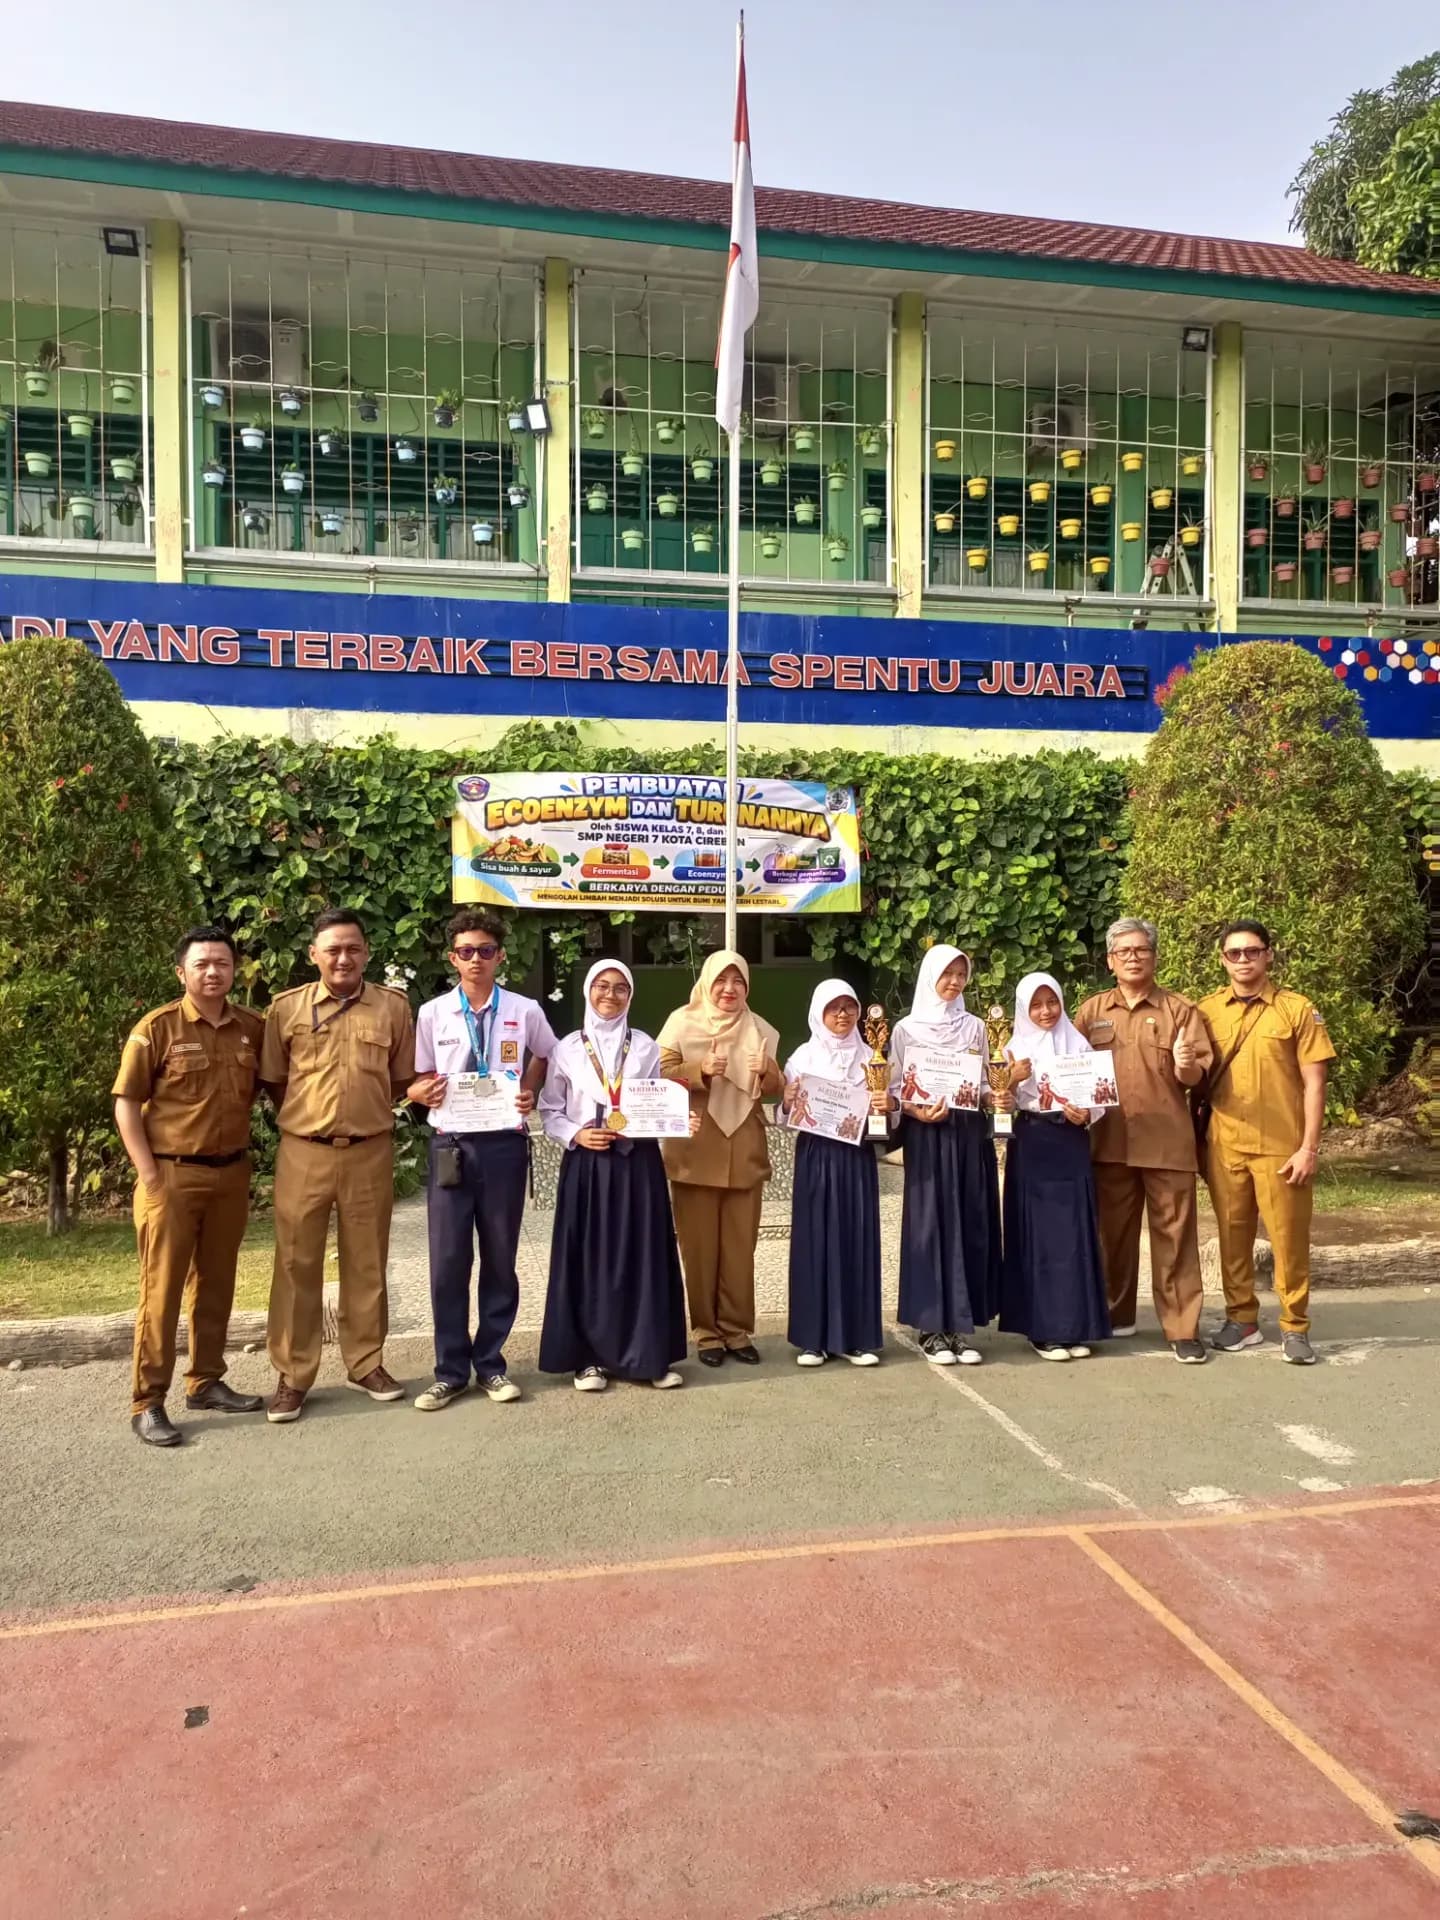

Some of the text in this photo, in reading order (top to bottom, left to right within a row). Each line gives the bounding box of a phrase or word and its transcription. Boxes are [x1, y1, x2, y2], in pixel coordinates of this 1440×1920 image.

[0, 616, 1126, 698] DI YANG TERBAIK BERSAMA SPENTU JUARA
[485, 796, 629, 831] ECOENZYM
[630, 798, 674, 820] DAN
[590, 822, 612, 831] Oleh
[614, 823, 649, 832] SISWA
[651, 824, 684, 834] KELAS
[706, 827, 724, 835] dan
[577, 832, 603, 842] SMP
[606, 833, 649, 843] NEGERI
[652, 835, 659, 843] 7
[661, 835, 692, 845] KOTA
[480, 862, 553, 875] Sisa buah & sayur
[592, 866, 639, 876] Fermentasi
[588, 882, 648, 892] BERKARYA
[651, 884, 697, 894] DENGAN
[537, 893, 578, 901] MENGOLAH
[580, 894, 607, 902] LIMBAH
